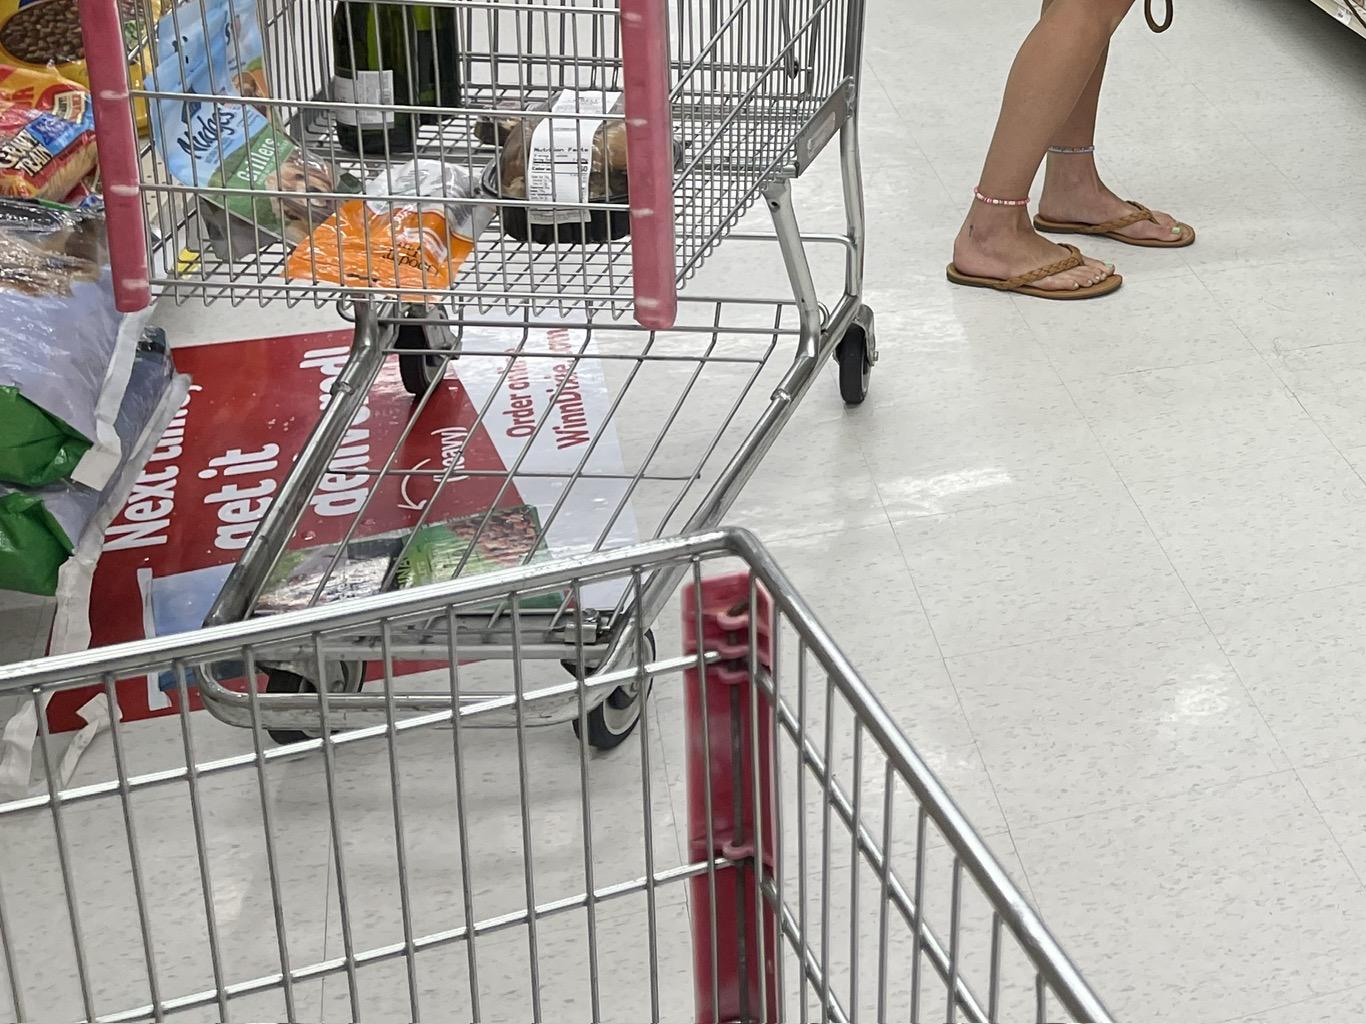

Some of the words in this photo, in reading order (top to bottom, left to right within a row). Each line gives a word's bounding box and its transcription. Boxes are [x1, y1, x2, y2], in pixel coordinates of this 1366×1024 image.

[0, 129, 39, 169] GRAVY
[177, 108, 236, 160] Nudges
[15, 144, 53, 176] TRAIN
[236, 137, 281, 183] Grillers
[502, 394, 537, 438] Order
[198, 442, 280, 479] it
[101, 465, 179, 552] Next
[204, 478, 277, 550] get
